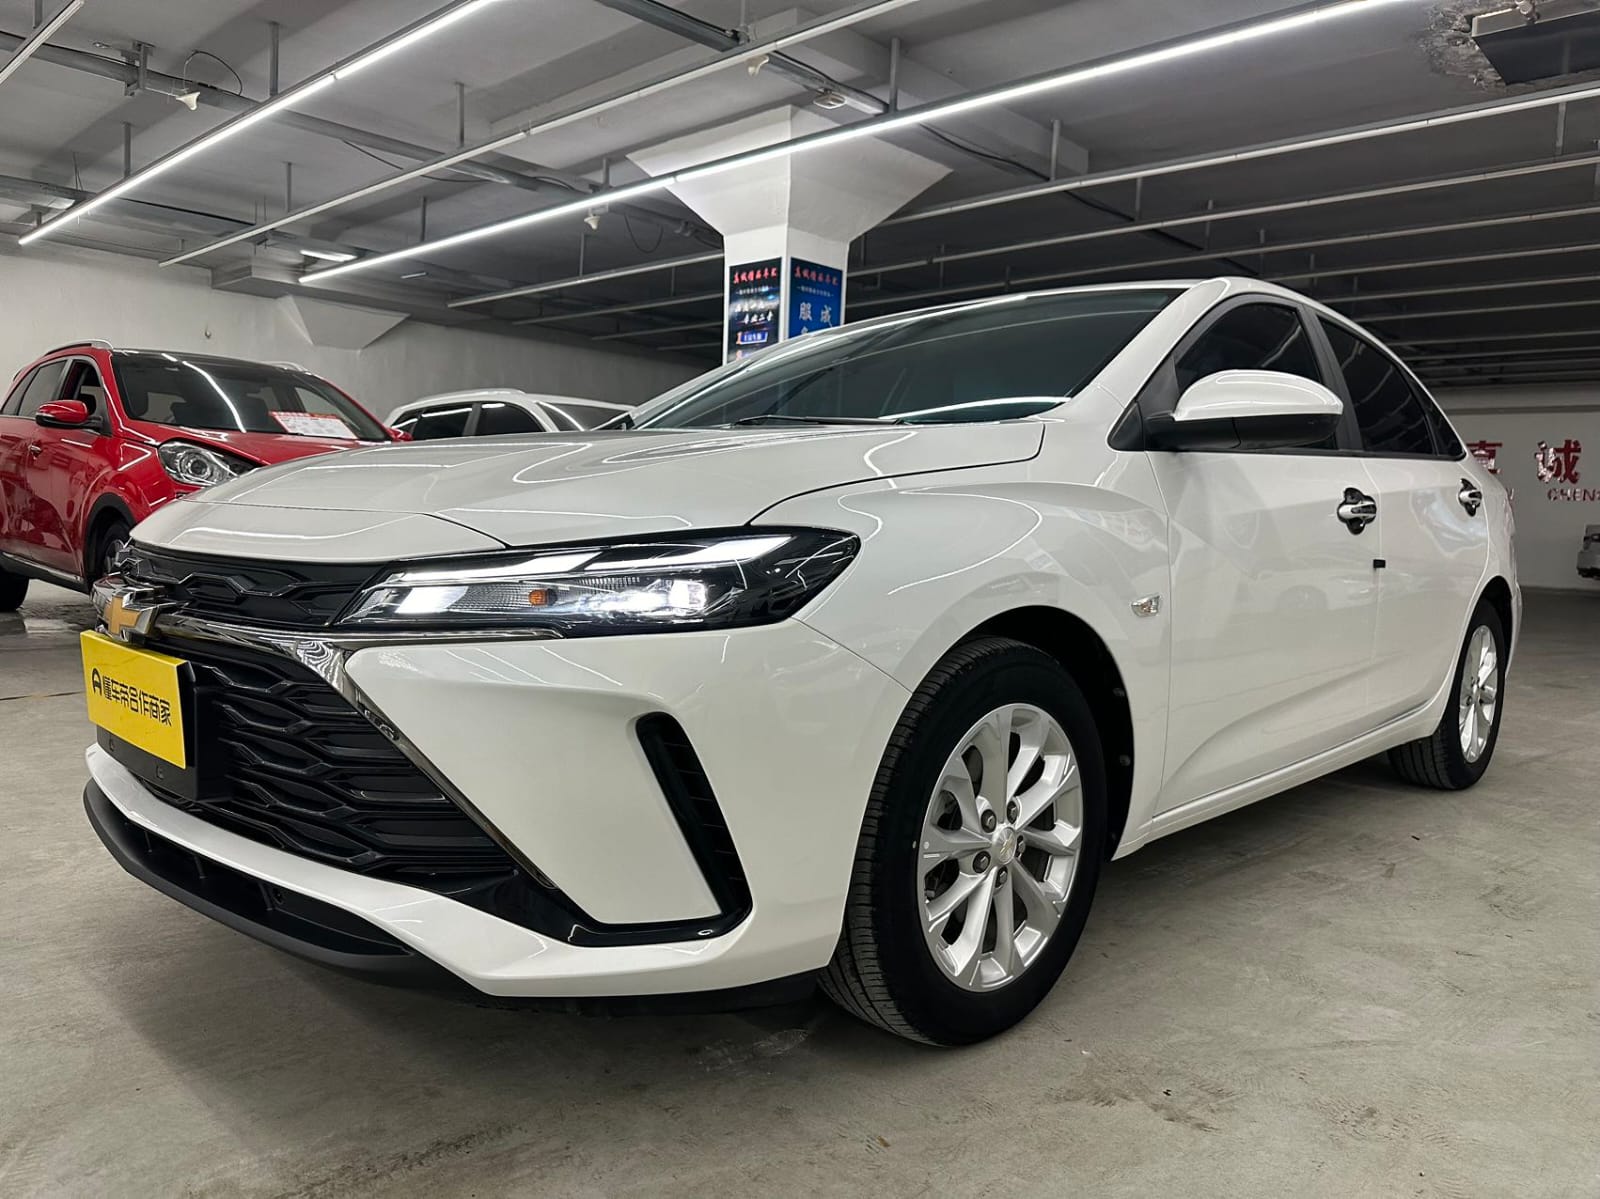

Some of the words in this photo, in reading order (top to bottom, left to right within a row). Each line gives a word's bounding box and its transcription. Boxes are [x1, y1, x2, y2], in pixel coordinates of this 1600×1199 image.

[102, 675, 172, 727] 懂车帝合作商家
